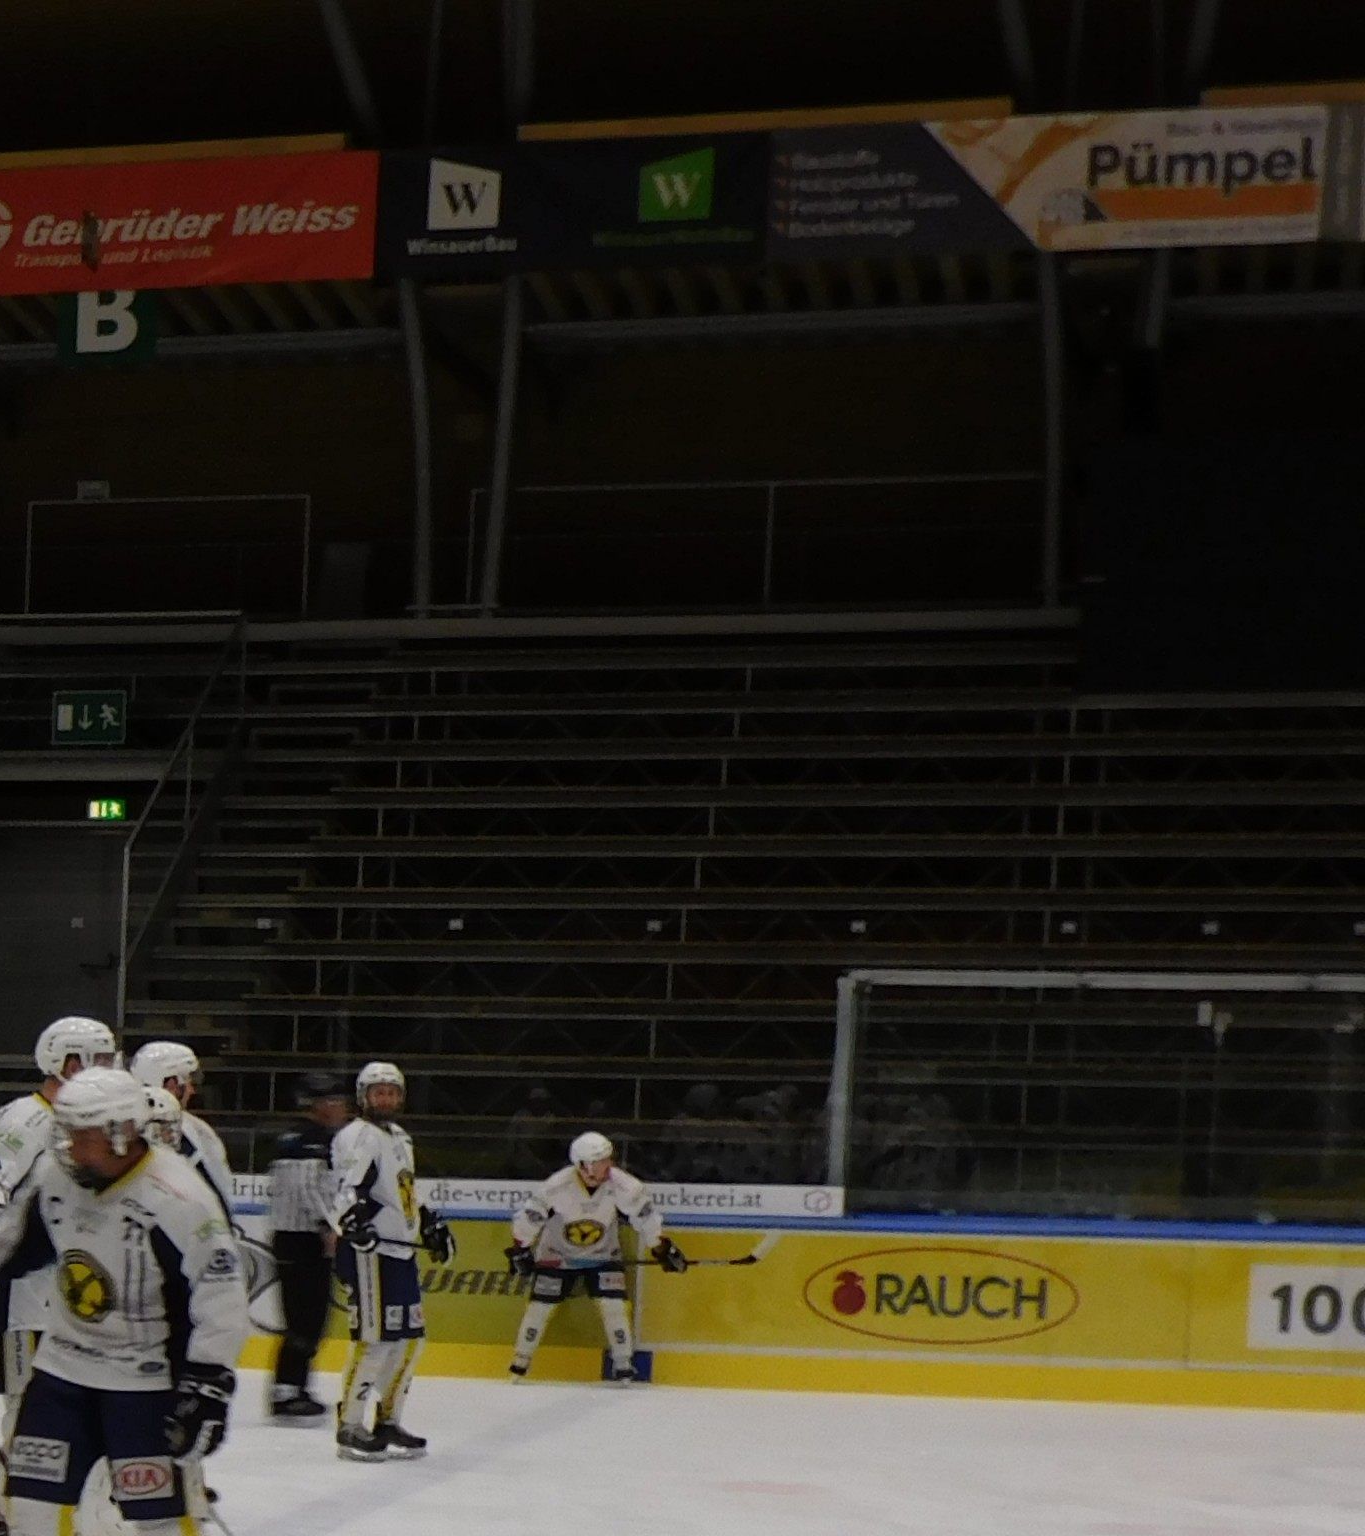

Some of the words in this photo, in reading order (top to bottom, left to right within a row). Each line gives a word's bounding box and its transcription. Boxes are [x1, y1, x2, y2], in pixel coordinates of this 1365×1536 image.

[651, 172, 702, 210] W
[1087, 136, 1319, 199] Pümpel
[441, 182, 487, 216] W
[22, 208, 224, 249] Gerüder
[231, 200, 361, 238] Weiss
[75, 289, 139, 354] B
[874, 1272, 1049, 1320] RAUCH
[1270, 1284, 1365, 1335] 10
[122, 1468, 158, 1487] KIA
